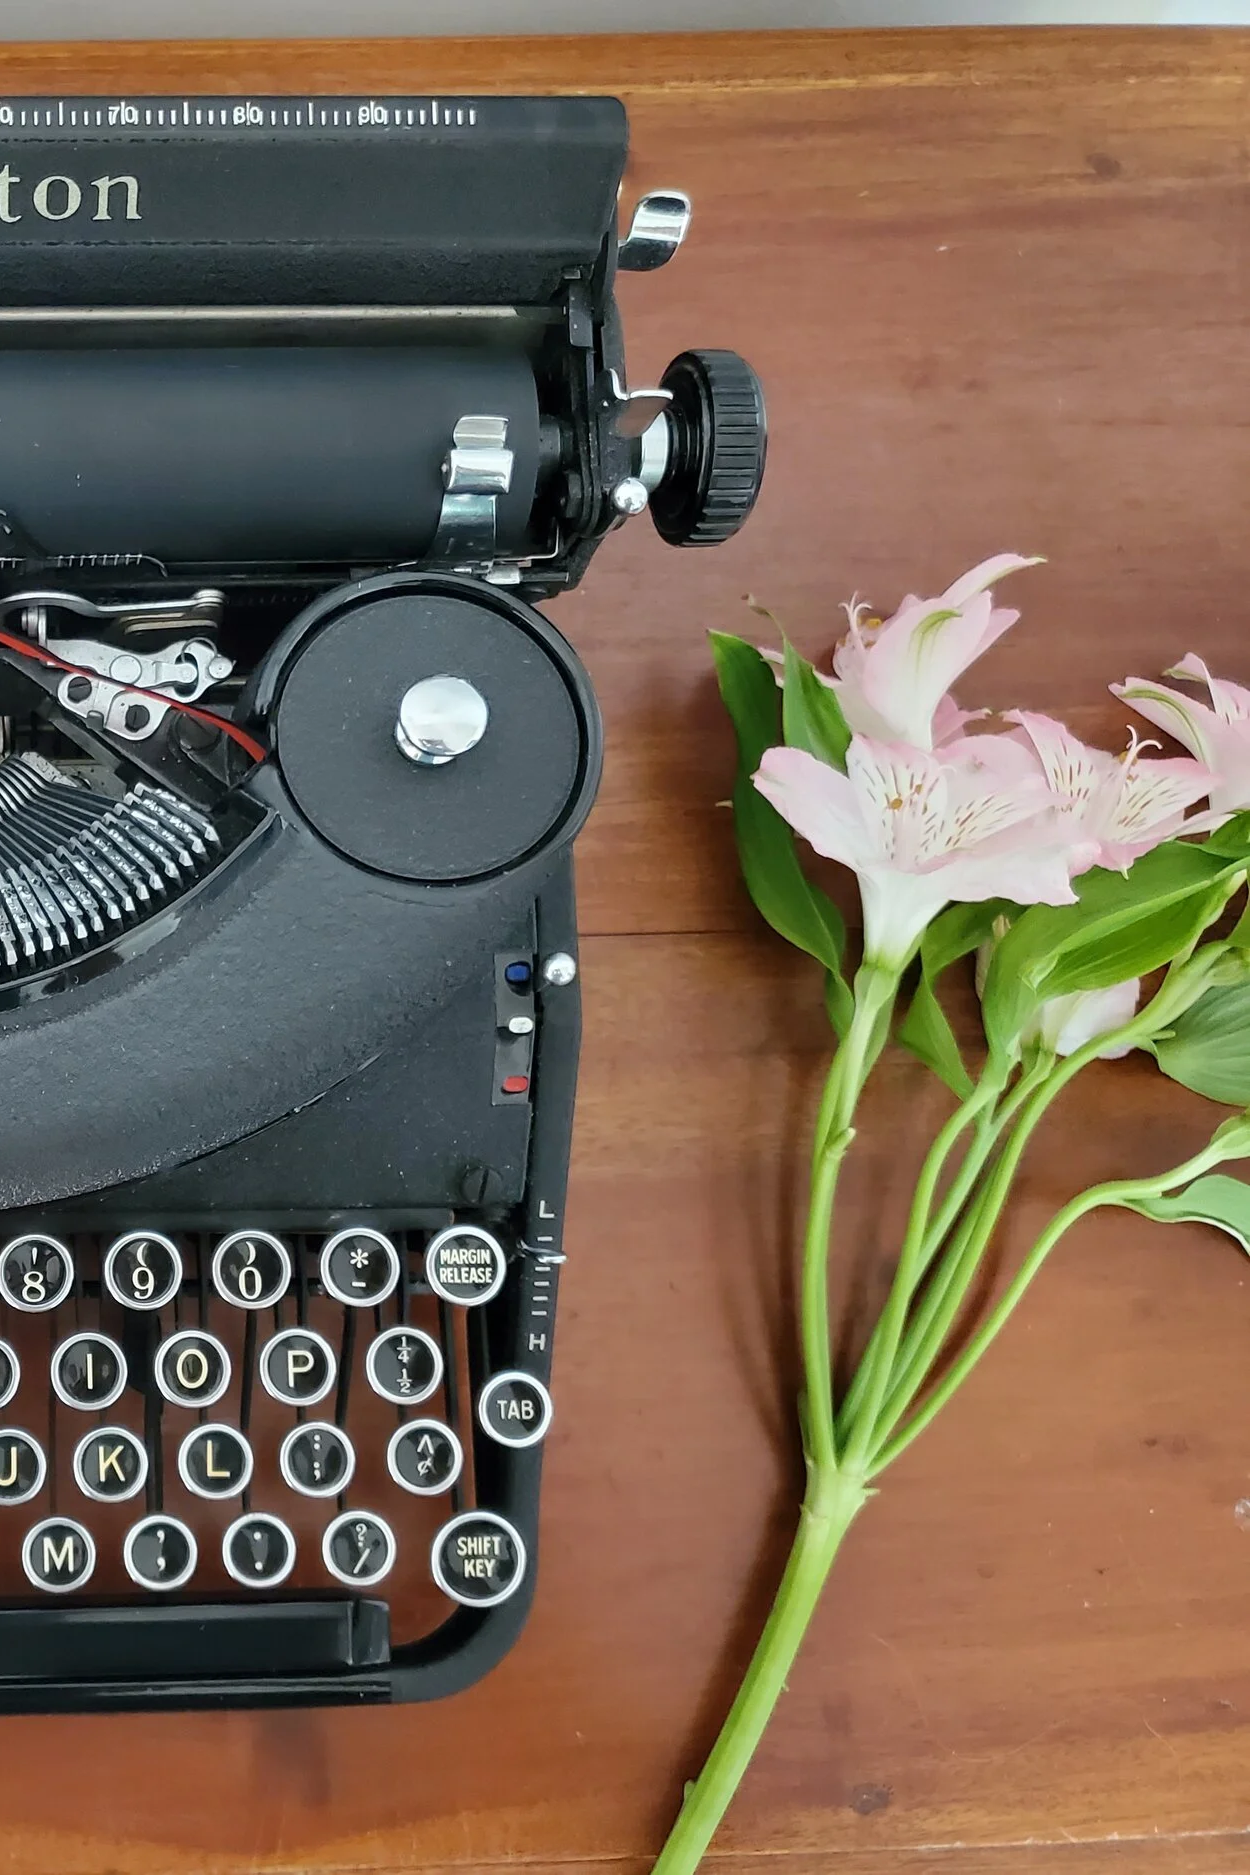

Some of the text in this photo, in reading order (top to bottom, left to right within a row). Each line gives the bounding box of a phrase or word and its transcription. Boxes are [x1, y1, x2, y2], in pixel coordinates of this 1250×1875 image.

[539, 1199, 555, 1219] L
[137, 1243, 148, 1266] (
[245, 1244, 256, 1266] )
[440, 1248, 490, 1268] MARGIN
[21, 1272, 47, 1303] 8
[132, 1265, 155, 1300] 9
[239, 1267, 263, 1301] 0
[439, 1267, 493, 1285] RELEASE
[528, 1333, 546, 1351] H
[86, 1353, 94, 1390] I
[176, 1348, 209, 1389] O
[287, 1349, 315, 1388] P
[496, 1399, 535, 1420] TAB
[98, 1445, 126, 1483] K
[206, 1439, 231, 1478] L
[356, 1524, 368, 1546] ?
[456, 1535, 501, 1556] SHIFT
[43, 1535, 75, 1573] M
[353, 1548, 370, 1574] /
[464, 1558, 496, 1578] KEY
